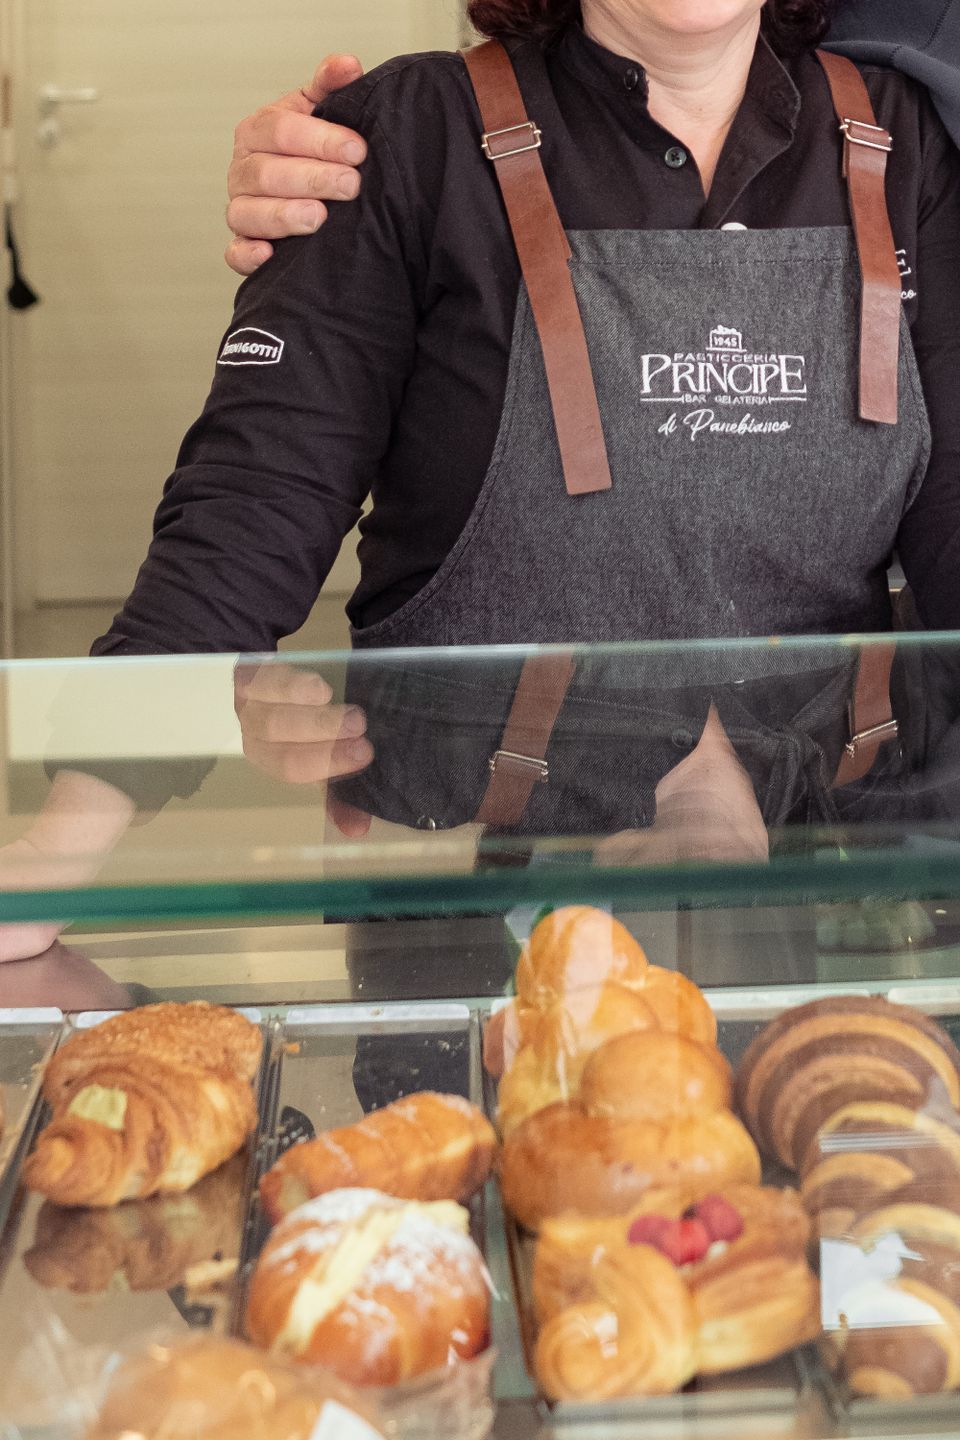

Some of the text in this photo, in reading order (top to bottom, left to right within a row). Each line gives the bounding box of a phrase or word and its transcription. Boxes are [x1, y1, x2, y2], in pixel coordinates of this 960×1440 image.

[713, 336, 738, 348] 1945
[673, 352, 778, 363] PASTICCERIA
[640, 353, 807, 394] PRINCIPE
[684, 395, 769, 405] BAR GELATERIA
[657, 408, 791, 441] di Panebianco
